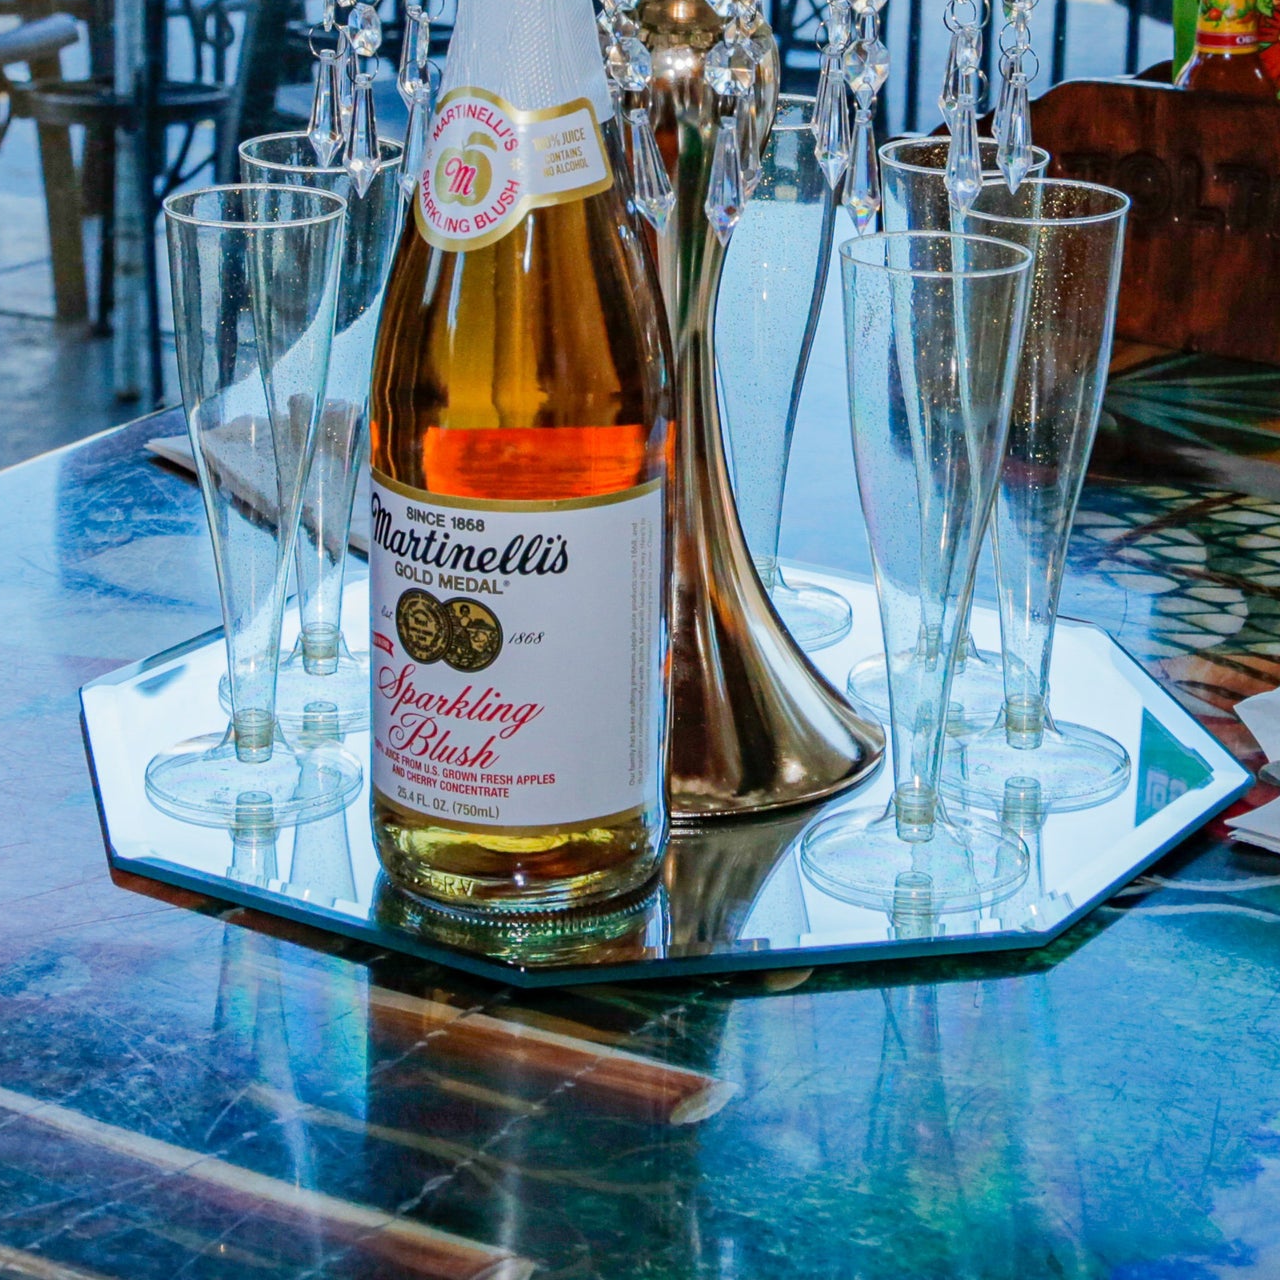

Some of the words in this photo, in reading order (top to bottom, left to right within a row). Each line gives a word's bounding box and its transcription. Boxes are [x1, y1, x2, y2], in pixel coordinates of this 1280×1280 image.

[433, 103, 519, 152] MARTINELLI'S
[562, 128, 586, 145] JUICE
[544, 146, 583, 164] CONTAINS
[556, 158, 589, 175] ALCOHOL
[422, 169, 470, 233] SPARKLING
[473, 179, 521, 230] BLUSH
[371, 492, 569, 576] Martinelli's
[406, 506, 446, 528] SINCE
[450, 517, 485, 532] 1868
[395, 561, 434, 585] GOLD
[438, 573, 504, 595] MEDAL
[508, 631, 545, 645] 1868
[377, 663, 545, 740] Sparkling
[388, 712, 501, 770] Blush
[392, 764, 405, 778] AND
[406, 770, 438, 788] CHERRY
[439, 781, 510, 798] CONCENTRATE
[401, 755, 422, 771] FROM
[424, 763, 440, 777] U.S.
[442, 767, 478, 783] GROWN
[480, 773, 513, 785] FRESH
[516, 773, 556, 785] APPLES
[397, 784, 415, 802] 25.4
[416, 793, 430, 808] FL.
[433, 798, 449, 813] OZ.
[452, 801, 500, 819] (750mL)
